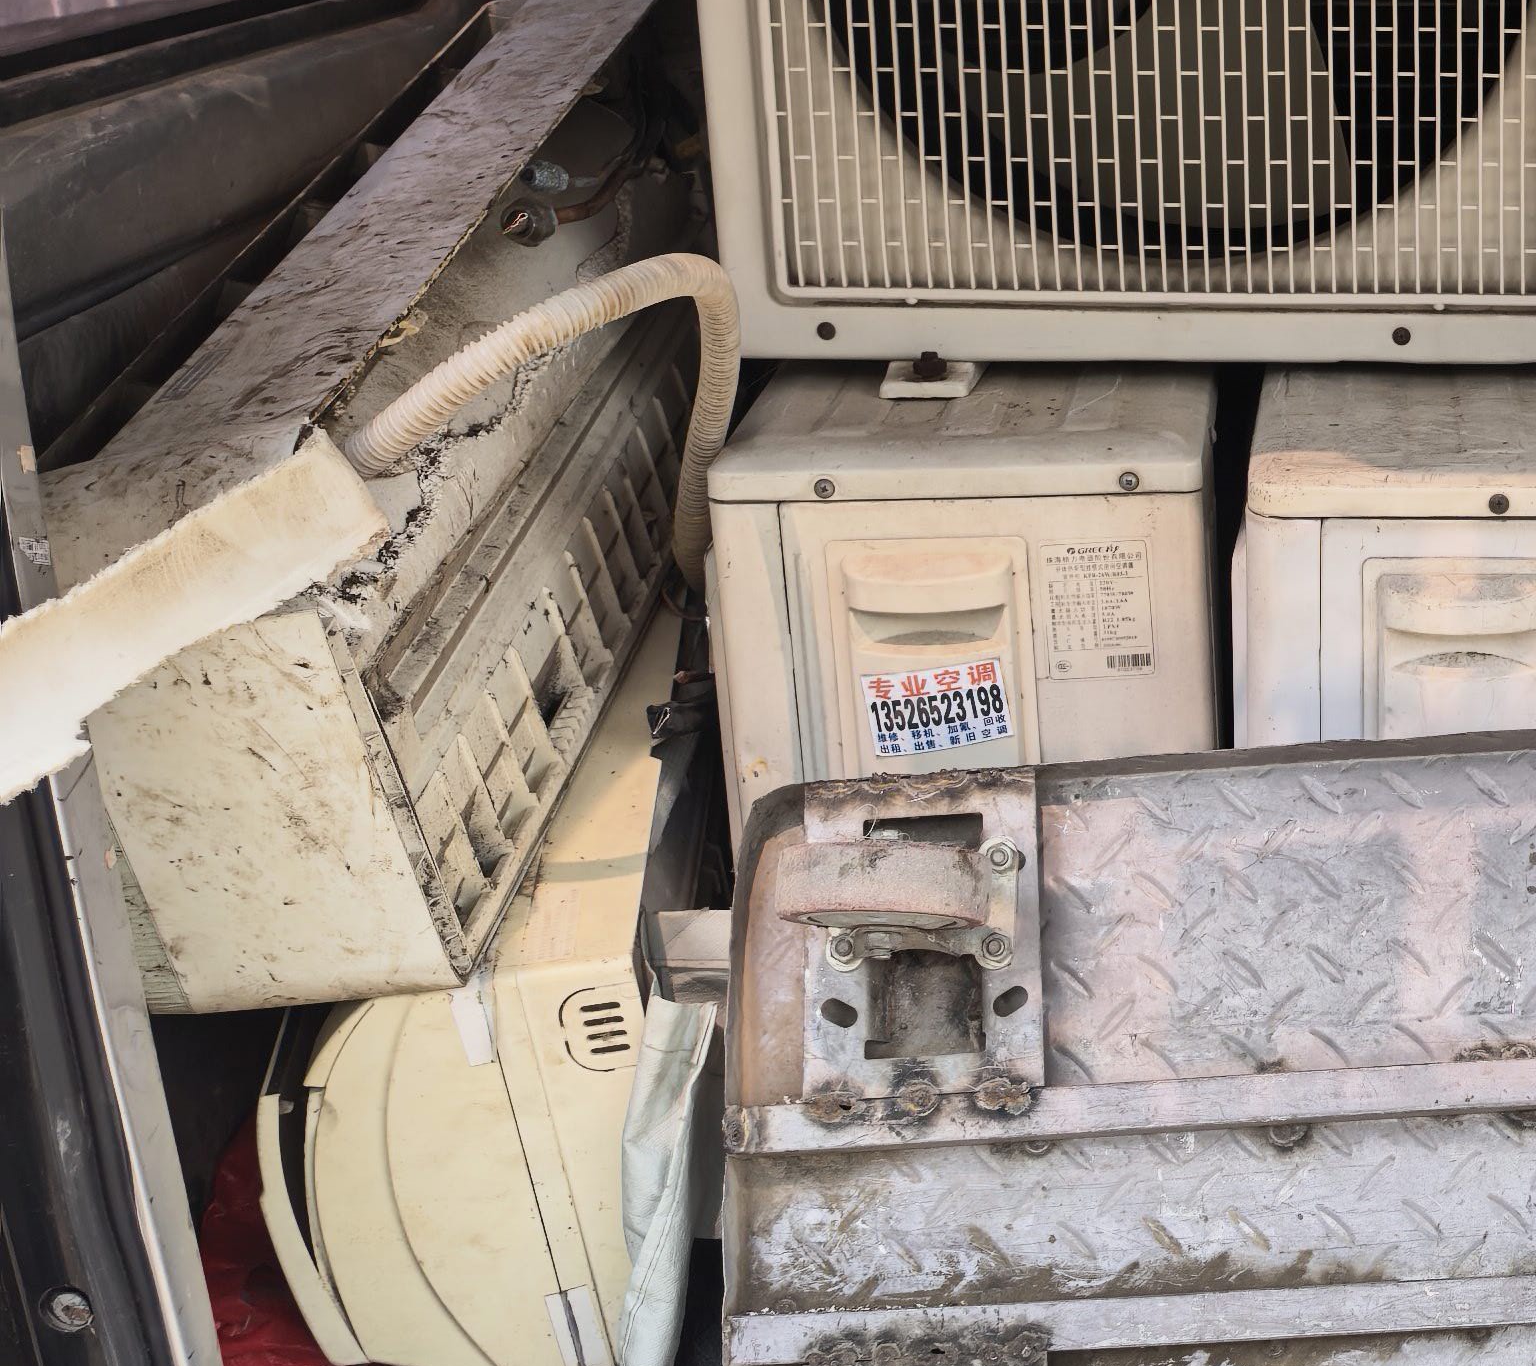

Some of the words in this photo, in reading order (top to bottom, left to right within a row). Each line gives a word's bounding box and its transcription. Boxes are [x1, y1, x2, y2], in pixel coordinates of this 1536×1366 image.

[868, 662, 997, 699] 专业空调
[871, 684, 1003, 732] 13526523198
